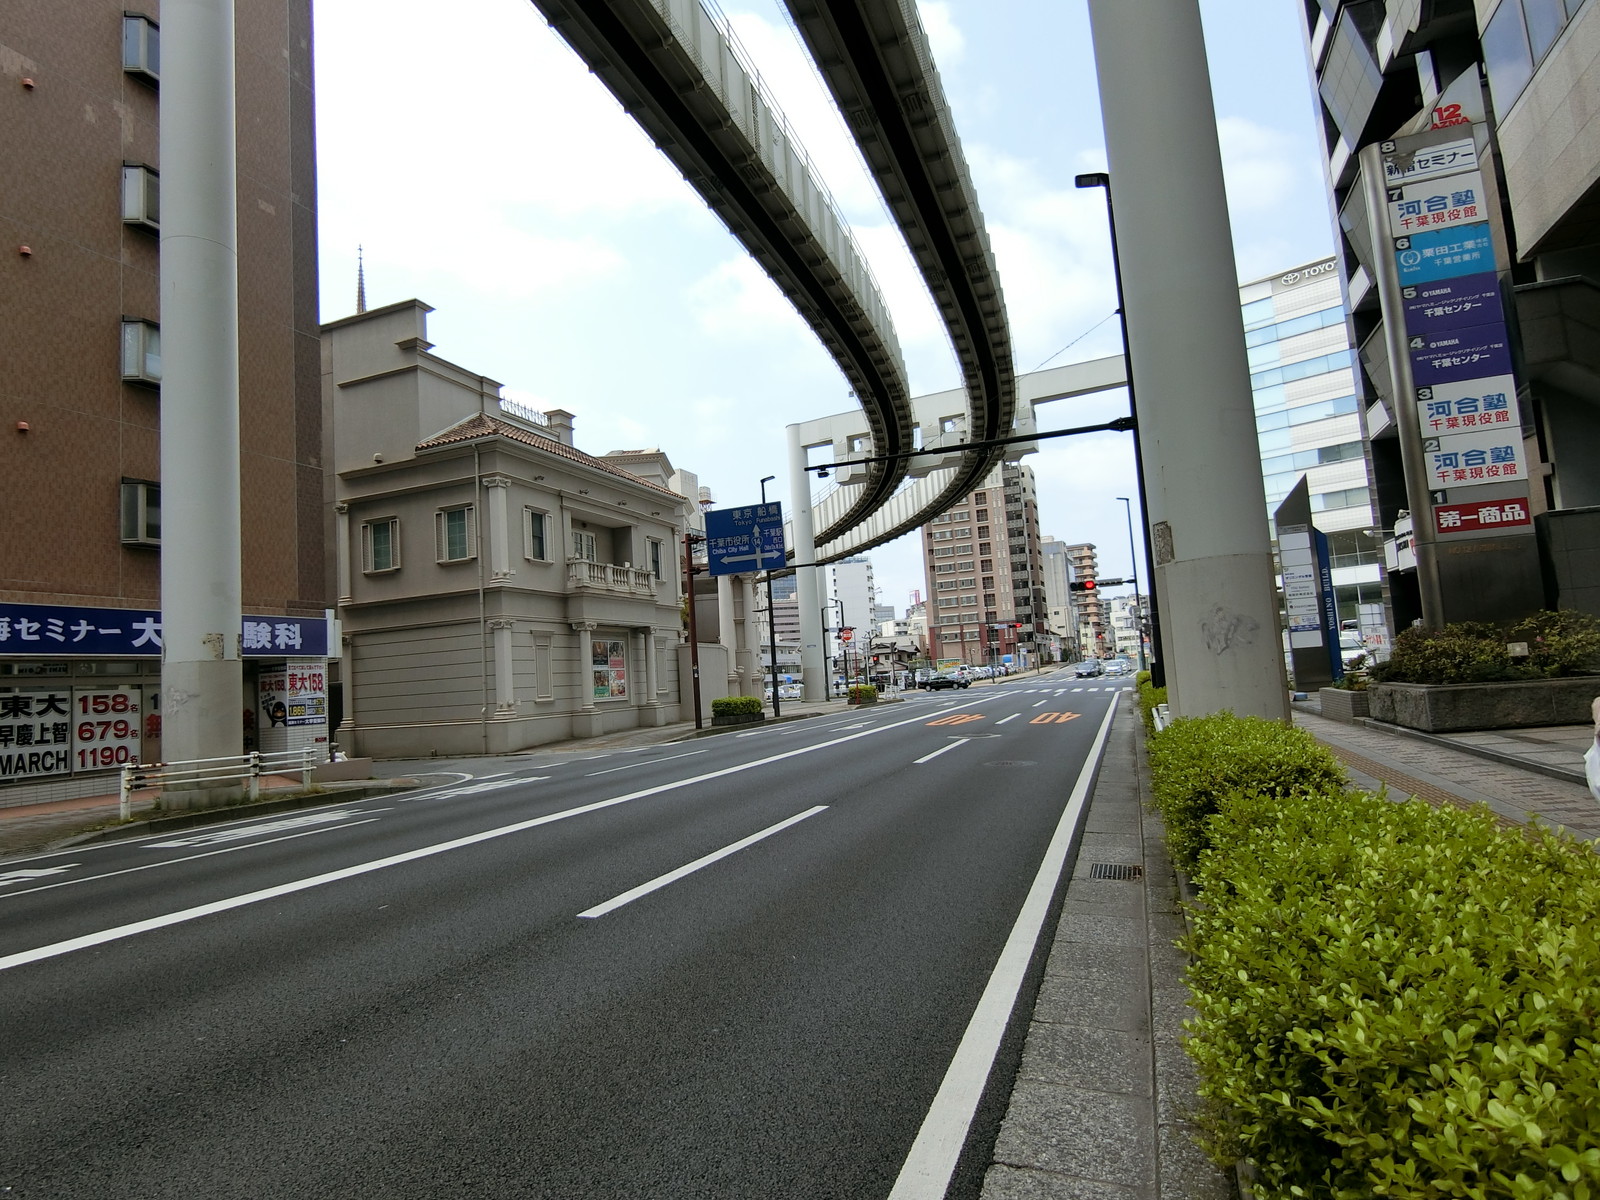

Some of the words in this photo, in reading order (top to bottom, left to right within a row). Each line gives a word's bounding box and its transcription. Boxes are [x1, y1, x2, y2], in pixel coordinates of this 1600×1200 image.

[1434, 104, 1461, 121] 12
[1381, 141, 1395, 153] 8
[1389, 189, 1403, 200] 7
[1398, 190, 1476, 218] 河合塾
[1401, 206, 1478, 230] 千葉現役館
[1396, 239, 1410, 250] 6
[1303, 260, 1337, 279] TOYO
[1403, 288, 1417, 299] 5
[1429, 287, 1452, 296] YAMAHA
[1424, 302, 1482, 318] 千葉センター
[1410, 337, 1425, 349] 4
[1437, 338, 1460, 348] YAMAHA
[1432, 354, 1491, 369] 千葉センター
[1418, 388, 1432, 400] 3
[1427, 393, 1508, 418] 河合塾
[1430, 410, 1509, 431] 千葉現役館
[1424, 440, 1439, 451] 2
[1434, 446, 1515, 470] 河合塾
[1437, 463, 1517, 483] 千葉現役館
[1434, 492, 1443, 503] 1
[733, 508, 753, 520] 東京
[1438, 504, 1525, 528] 第一商品
[709, 535, 750, 549] 千葉市役所
[1325, 597, 1336, 631] YOSHINO
[131, 617, 162, 648] 大
[243, 621, 302, 650] 験科
[0, 694, 69, 718] 東大
[78, 694, 139, 714] 158名
[1029, 711, 1082, 724] 40
[0, 722, 69, 748] 早慶上智
[78, 720, 139, 742] 679名
[0, 750, 69, 775] MARCH
